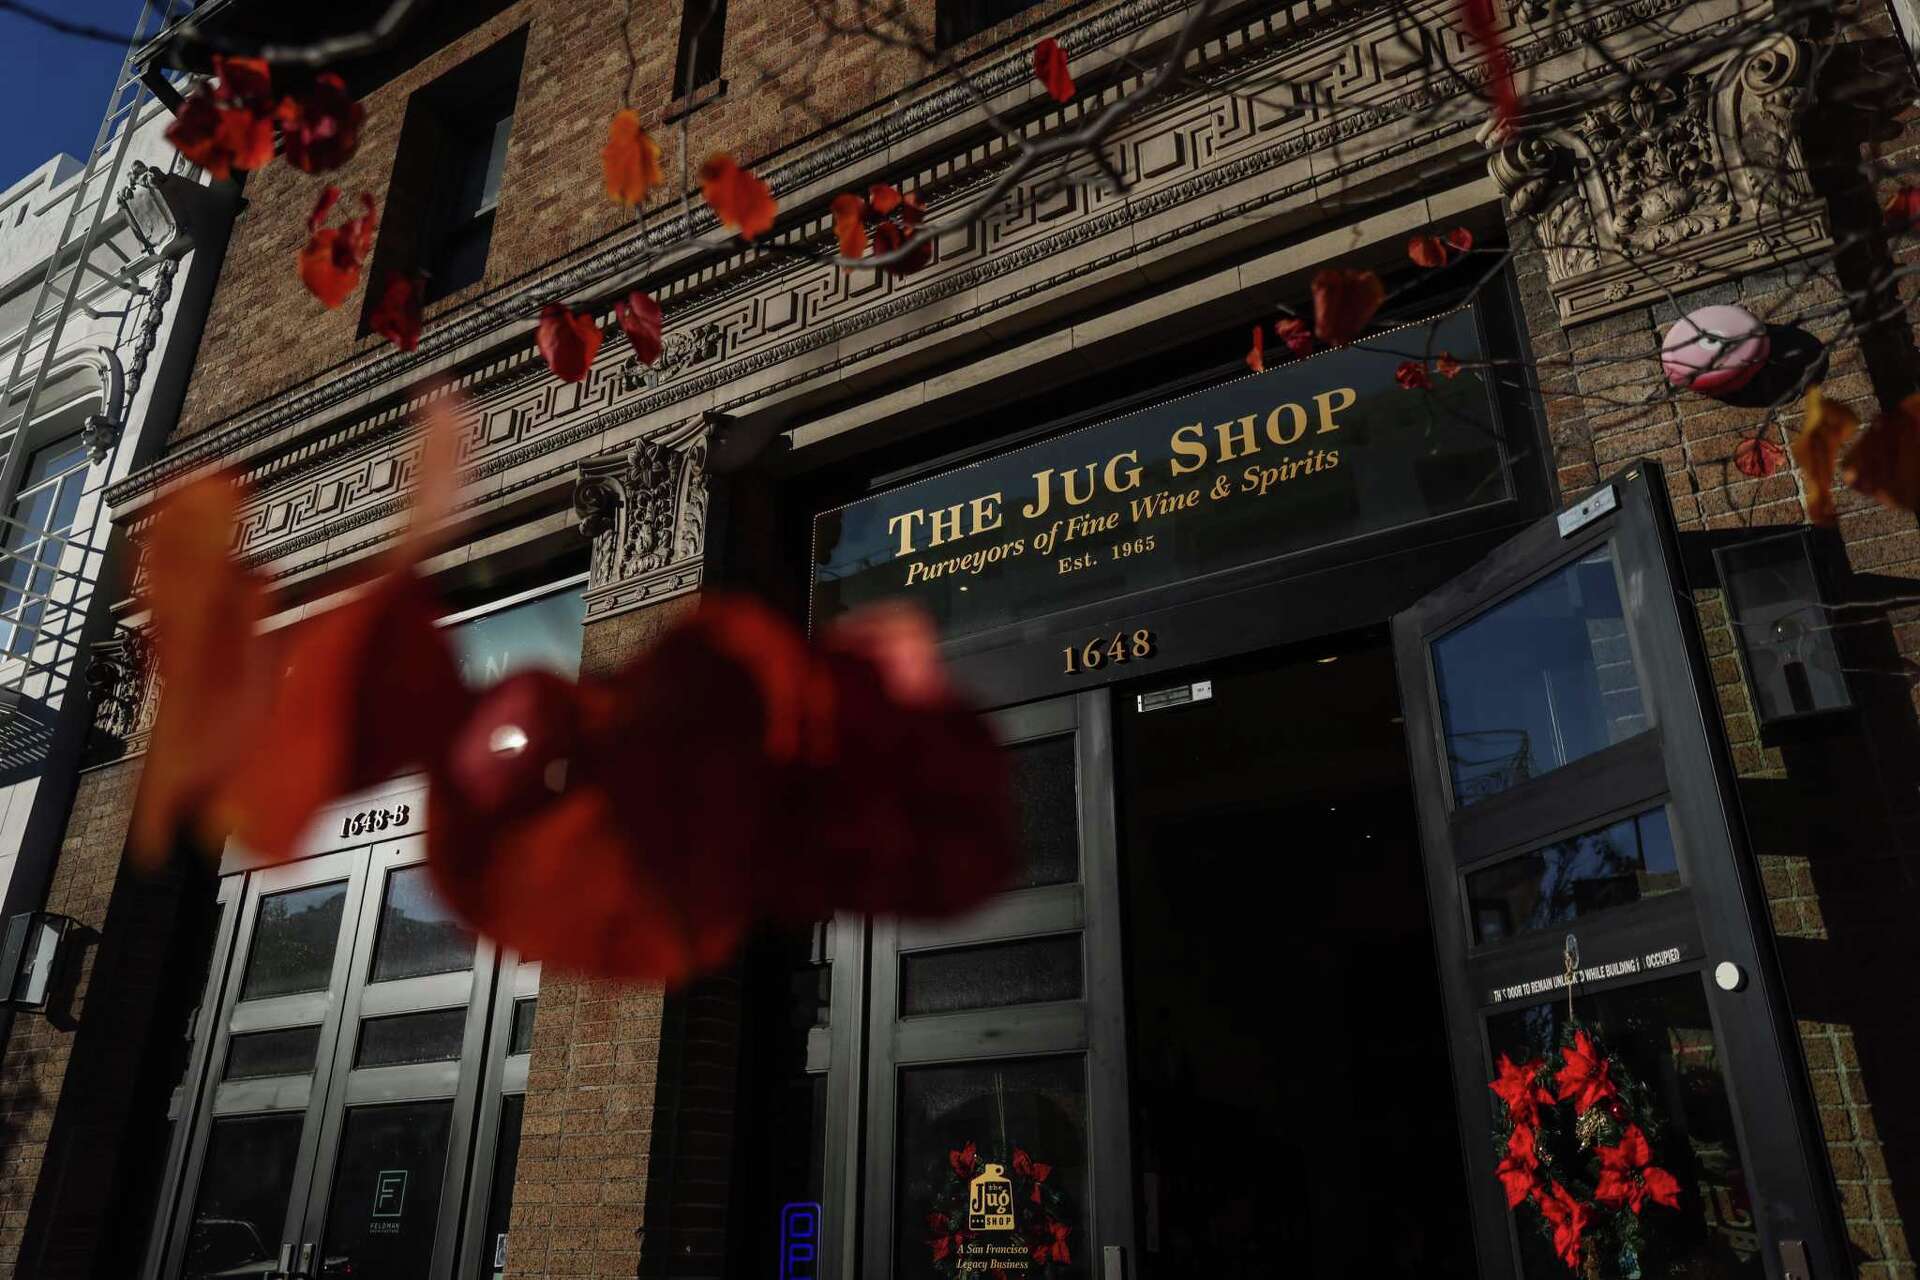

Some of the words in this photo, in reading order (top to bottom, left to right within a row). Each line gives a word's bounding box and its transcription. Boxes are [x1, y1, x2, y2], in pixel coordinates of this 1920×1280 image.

[889, 491, 1004, 559] THE
[1023, 450, 1144, 518] JUG
[1170, 387, 1358, 477] SHOP
[905, 534, 1024, 586] Purveyors
[1034, 522, 1060, 556] of
[1064, 511, 1119, 543] Fine
[1130, 487, 1200, 524] Wine
[1209, 474, 1232, 500] &
[1242, 448, 1340, 496] Spirits
[1058, 554, 1097, 576] Est.
[1112, 535, 1156, 561] 1965
[1063, 627, 1153, 675] 1648
[340, 804, 410, 838] 1648-B
[1508, 986, 1522, 999] DOOR
[1523, 984, 1531, 996] TO
[1531, 978, 1553, 994] REMAIN
[1585, 966, 1605, 983] WHILE
[1606, 960, 1636, 977] BUILDING
[1646, 947, 1680, 969] OCCUPIED
[972, 1183, 1010, 1214] Jug
[986, 1217, 1011, 1226] SHOP
[788, 1212, 815, 1280] OP
[957, 1259, 988, 1272] Legacy
[990, 1258, 1029, 1269] Business
[967, 1243, 984, 1254] San
[986, 1243, 1029, 1254] Francisco
